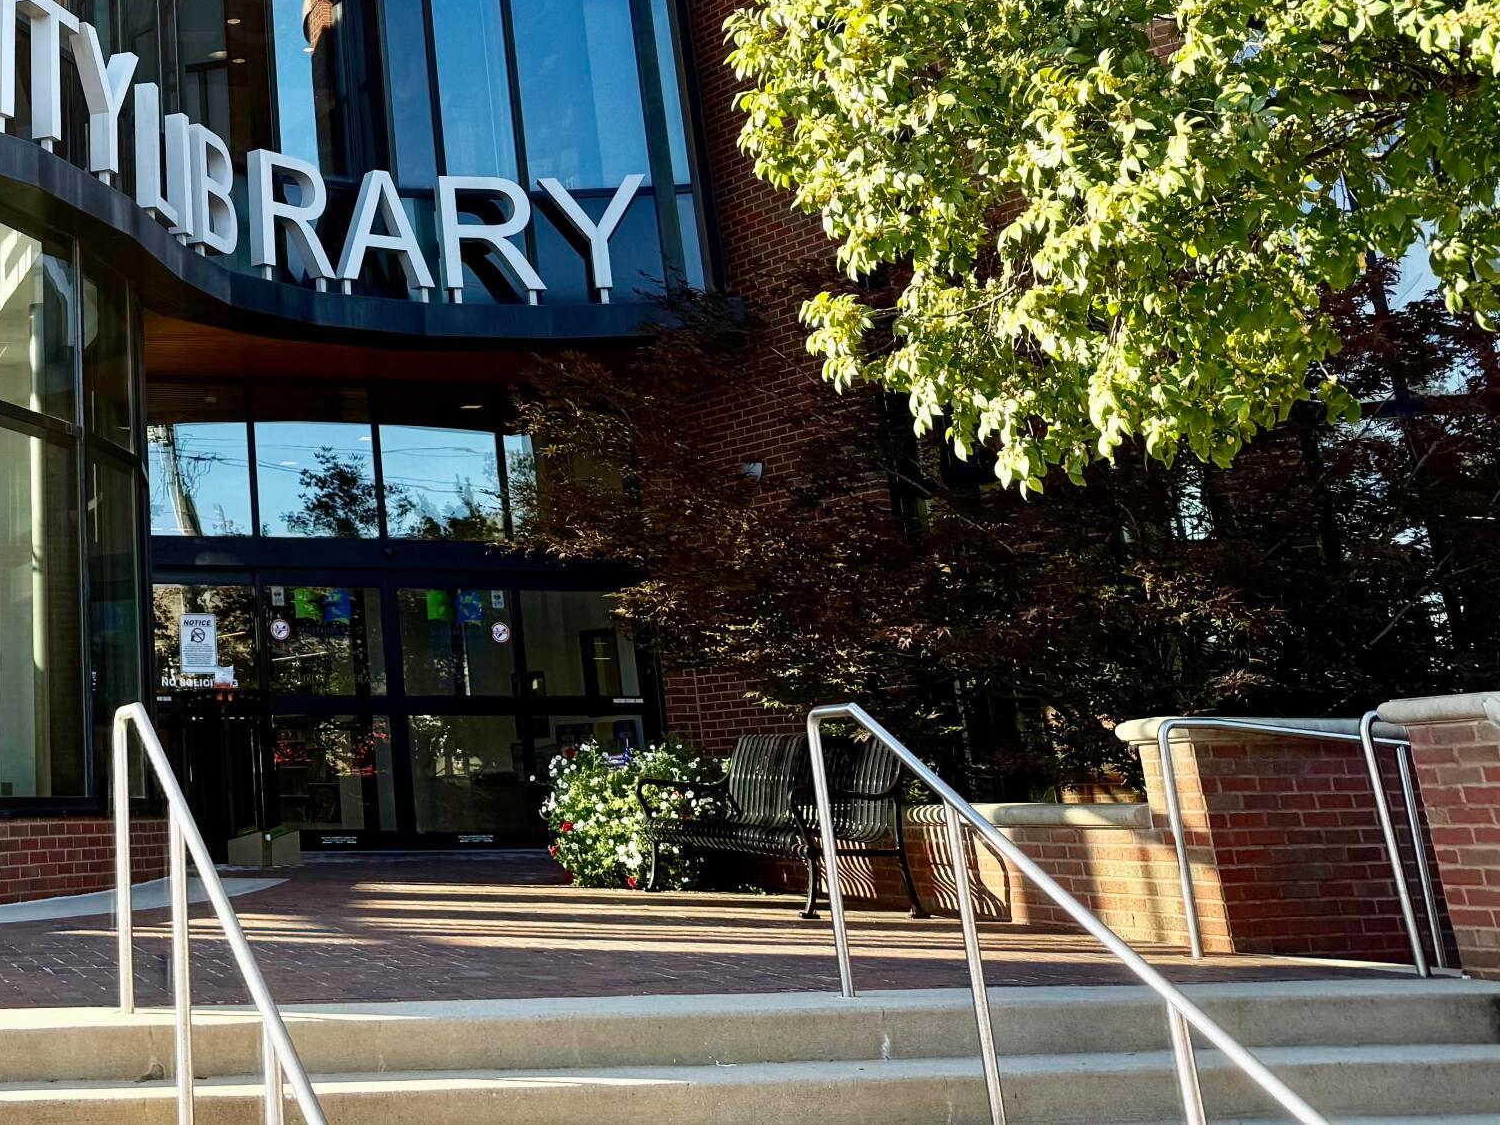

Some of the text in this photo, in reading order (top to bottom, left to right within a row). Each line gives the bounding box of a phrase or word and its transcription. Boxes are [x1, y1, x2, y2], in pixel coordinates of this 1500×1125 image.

[134, 82, 646, 294] LIBRARY
[161, 675, 239, 688] NO SOLICIG
